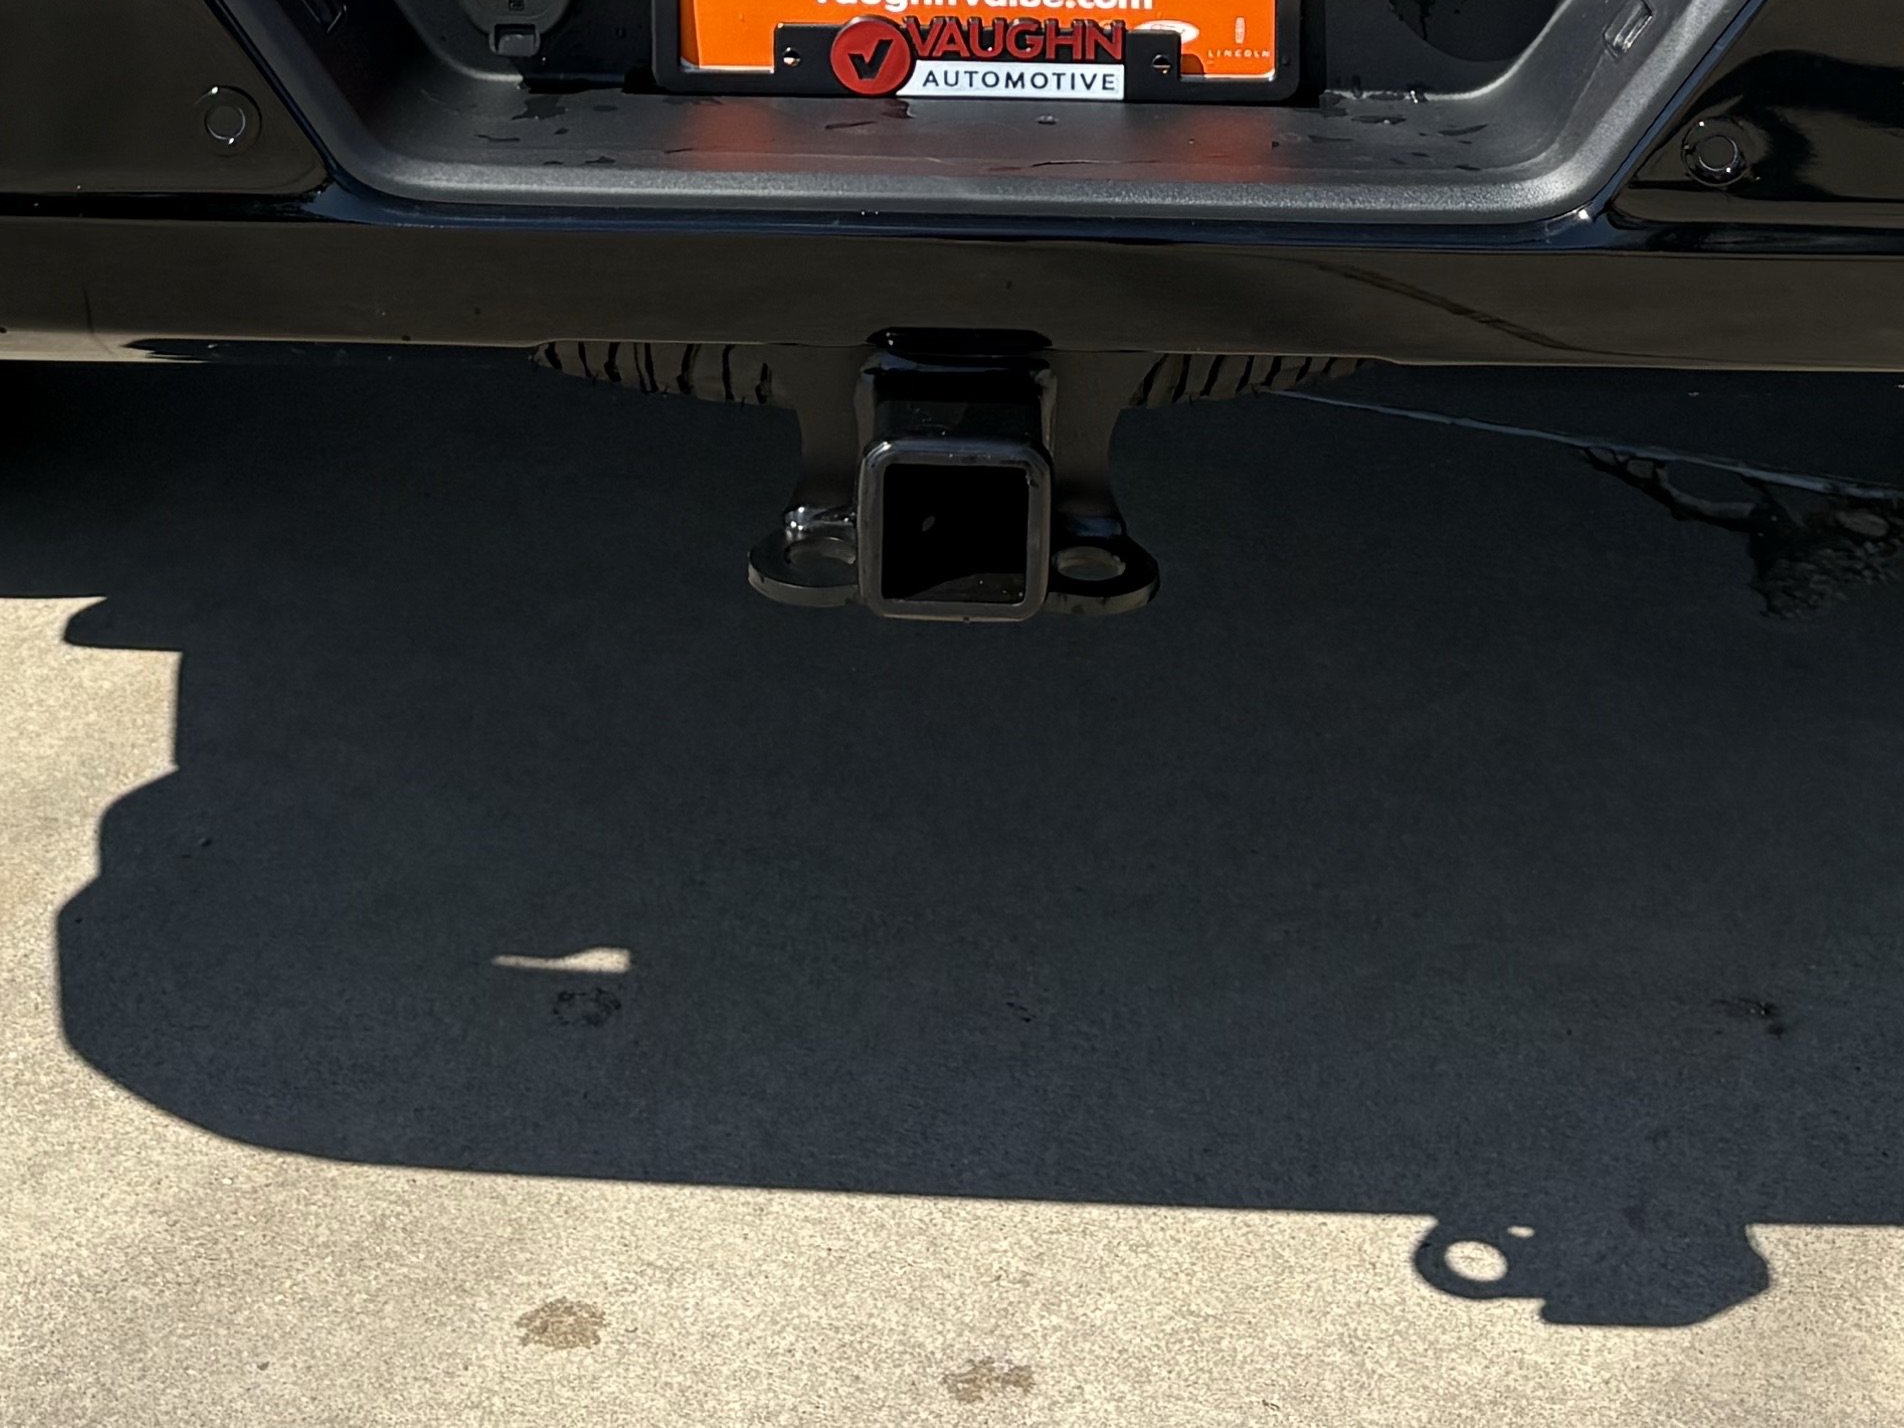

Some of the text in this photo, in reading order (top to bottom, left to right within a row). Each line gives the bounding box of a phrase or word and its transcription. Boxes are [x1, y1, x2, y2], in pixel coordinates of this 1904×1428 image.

[902, 16, 1122, 60] VAUGHN
[1208, 49, 1271, 58] LINCOLN
[923, 69, 1116, 92] AUTOMOTIVE
